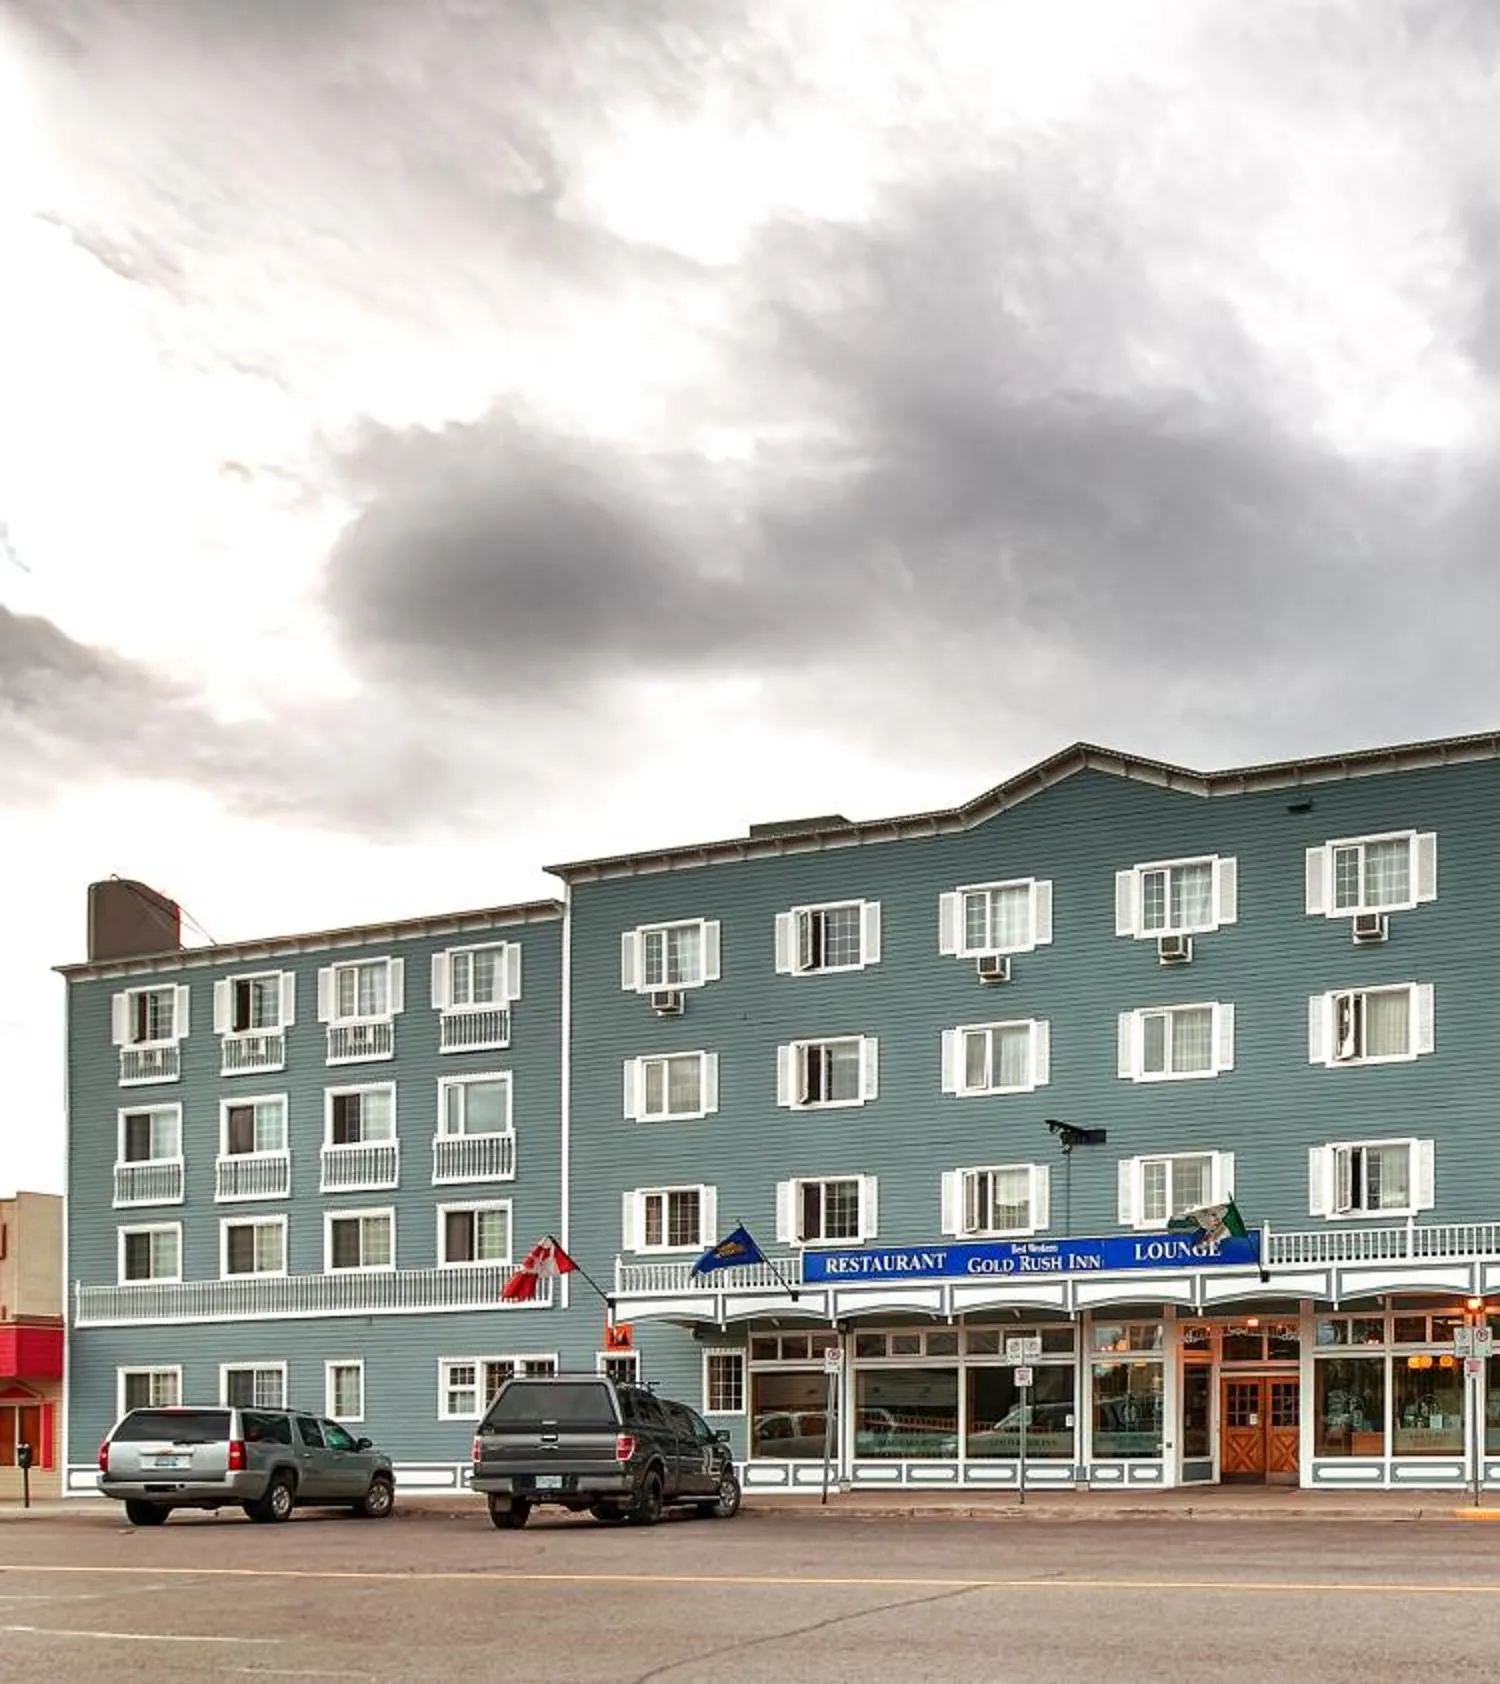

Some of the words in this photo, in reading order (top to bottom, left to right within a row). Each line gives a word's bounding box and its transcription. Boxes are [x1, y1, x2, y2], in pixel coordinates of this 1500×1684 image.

[1134, 1240, 1222, 1261] LOUNGE
[825, 1252, 947, 1273] RESTAURANT
[967, 1256, 1015, 1273] GOLD
[1019, 1254, 1062, 1271] RUSH
[1068, 1253, 1100, 1269] INN
